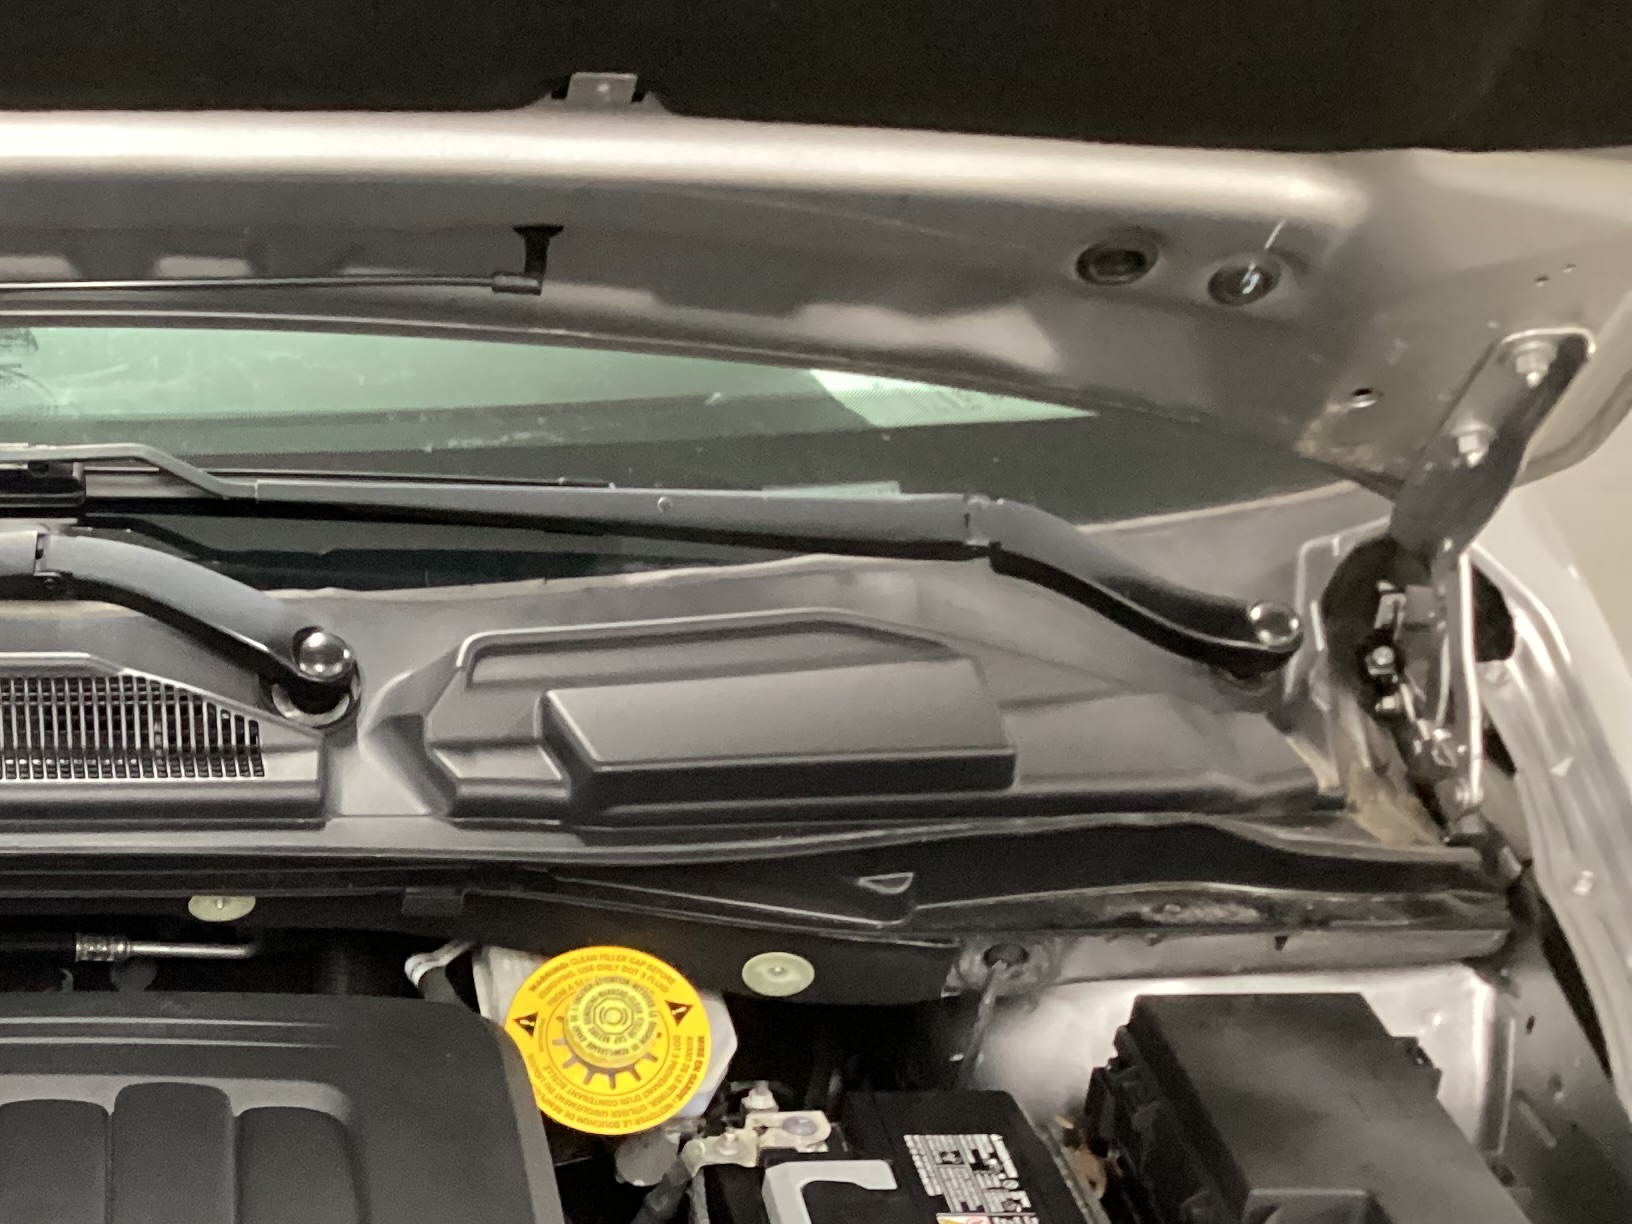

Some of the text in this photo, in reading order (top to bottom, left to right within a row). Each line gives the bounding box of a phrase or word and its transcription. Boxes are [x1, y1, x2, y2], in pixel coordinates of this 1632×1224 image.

[568, 954, 597, 966] CLEAN
[598, 953, 627, 962] FILLER
[628, 956, 647, 967] CAP
[621, 965, 639, 976] DOT
[672, 1034, 682, 1052] DOT
[562, 1109, 576, 1121] DE
